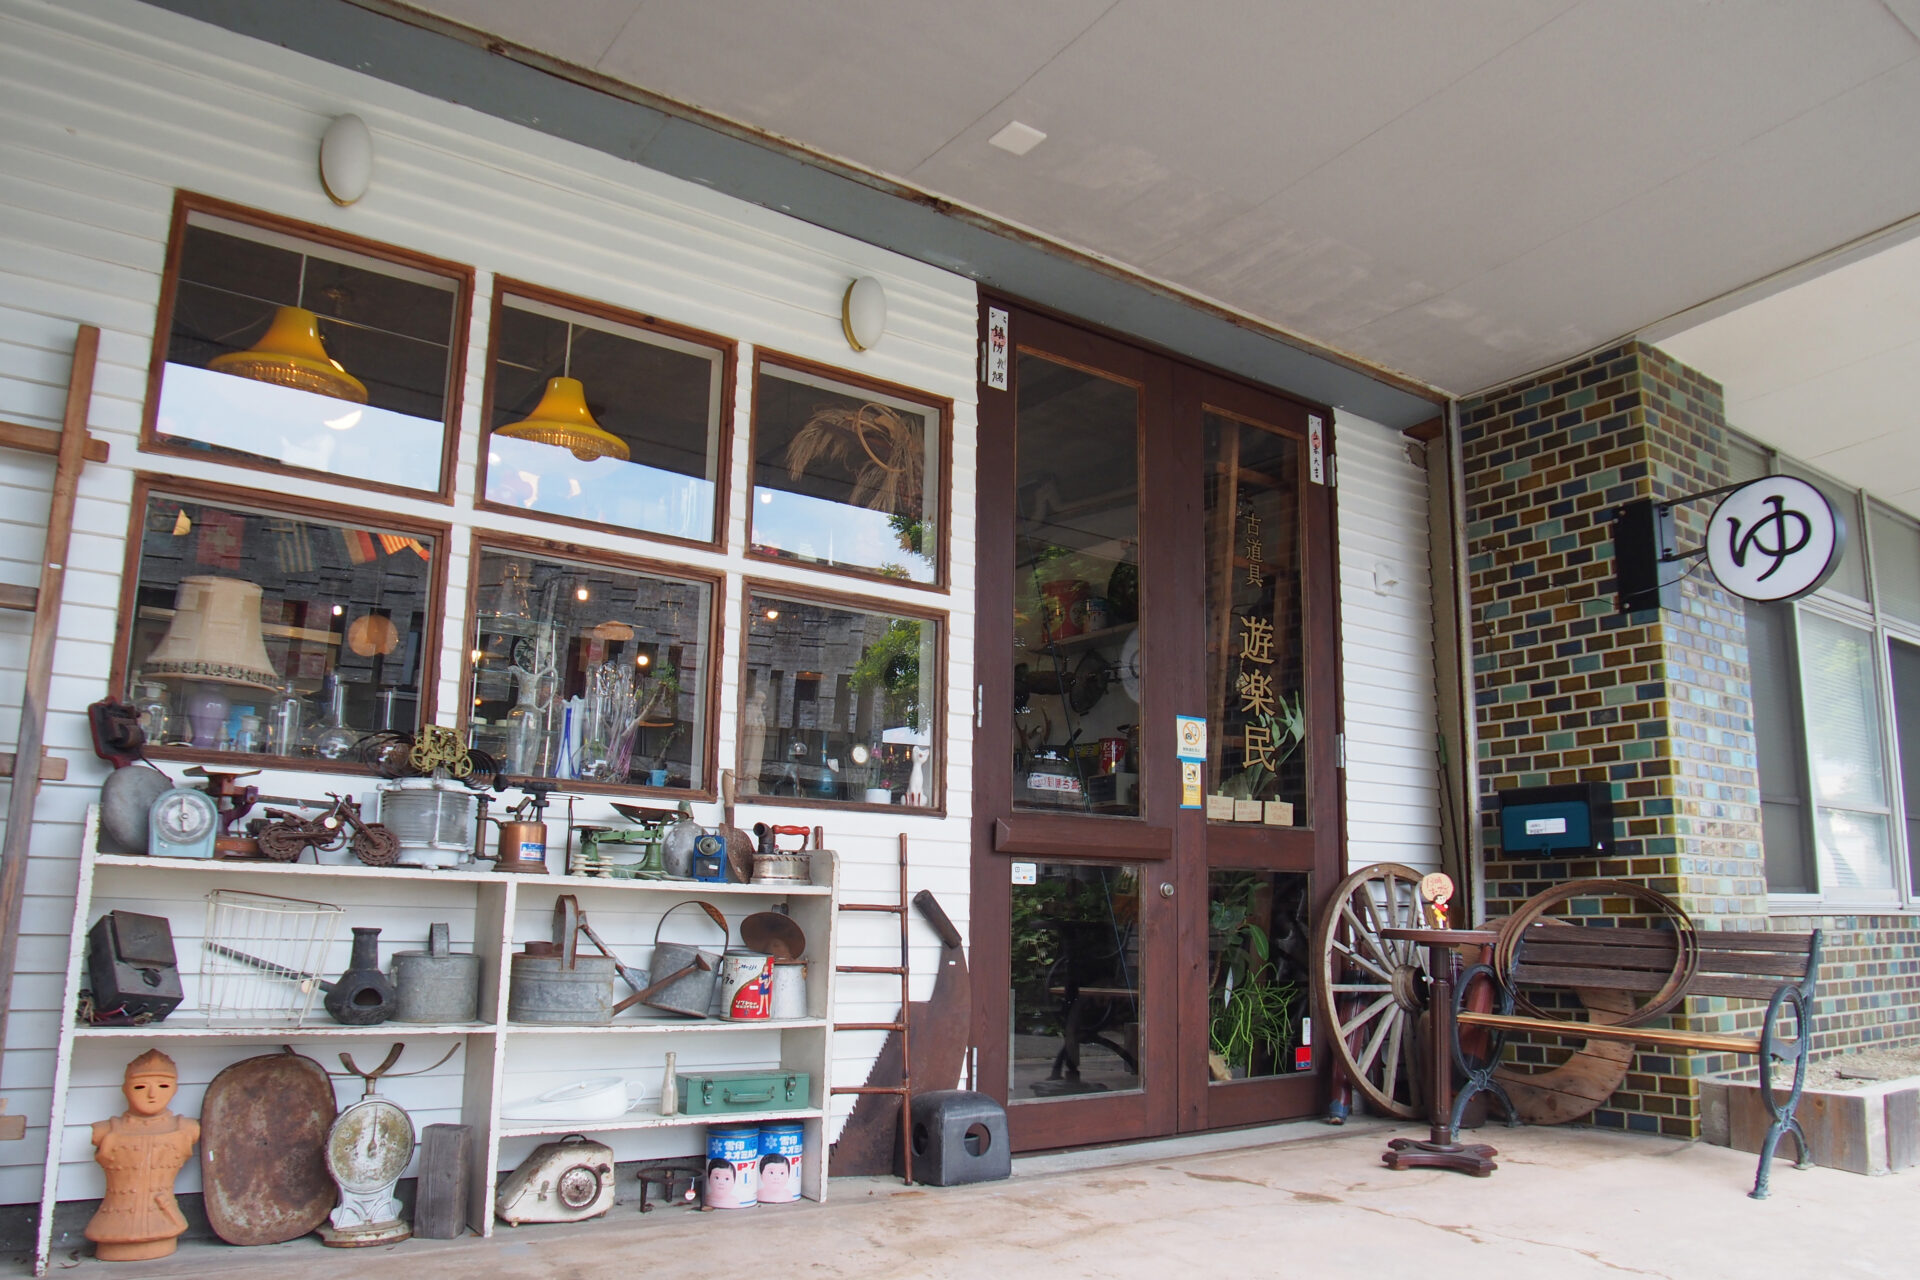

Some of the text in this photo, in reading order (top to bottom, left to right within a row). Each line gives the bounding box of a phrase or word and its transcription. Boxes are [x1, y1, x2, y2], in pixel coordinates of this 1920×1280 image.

[1244, 512, 1264, 588] 古道具
[1727, 495, 1811, 582] ゆ
[1239, 615, 1276, 777] 遊楽民
[724, 1140, 745, 1151] 雪印
[779, 1135, 798, 1145] 雪印
[737, 1161, 756, 1171] P7
